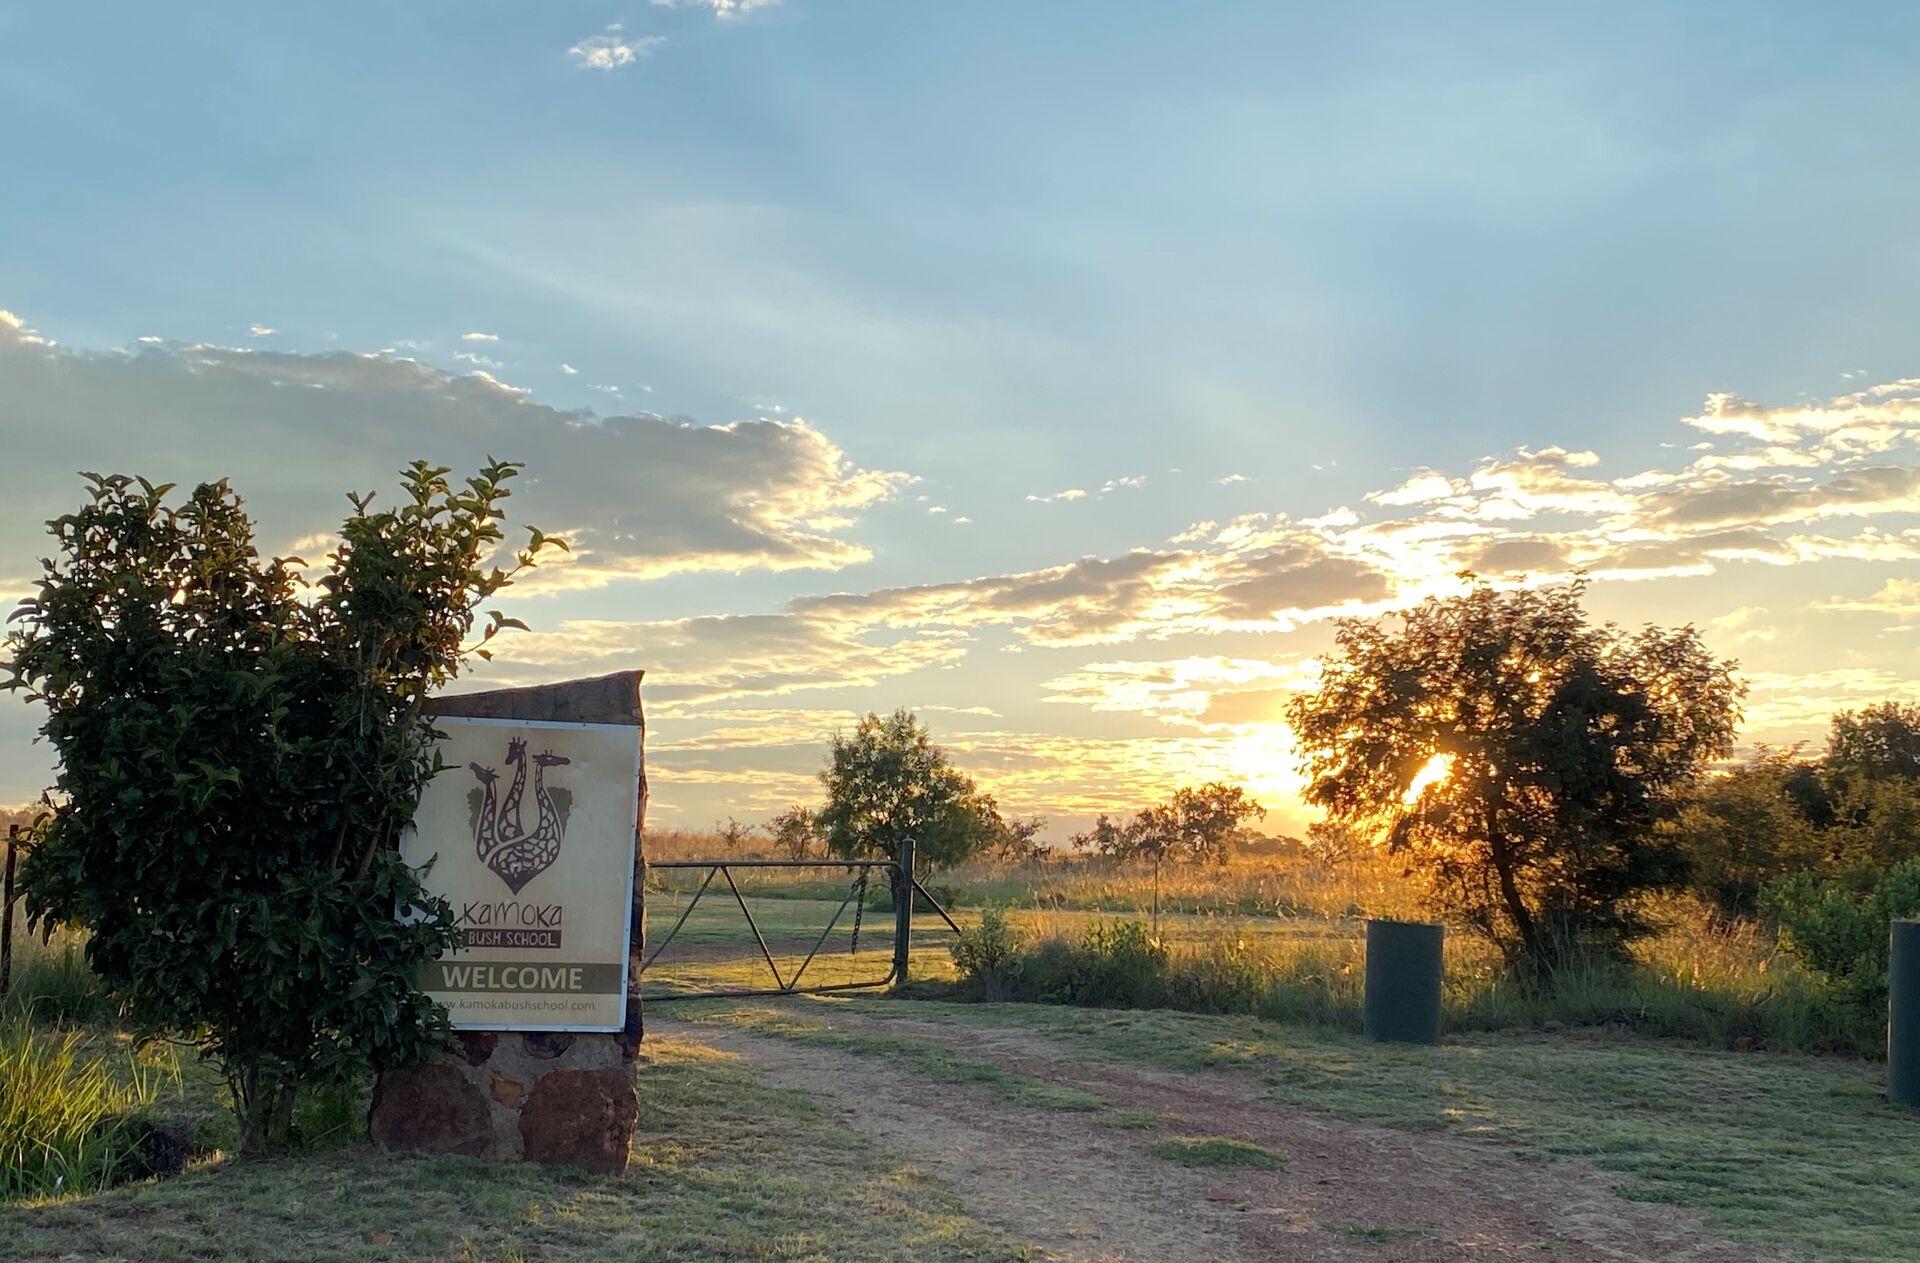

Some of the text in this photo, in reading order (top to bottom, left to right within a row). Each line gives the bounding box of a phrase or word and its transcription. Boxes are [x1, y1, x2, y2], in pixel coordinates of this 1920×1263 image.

[468, 931, 557, 946] BUSH SCHOOL
[442, 966, 583, 990] WELCOME
